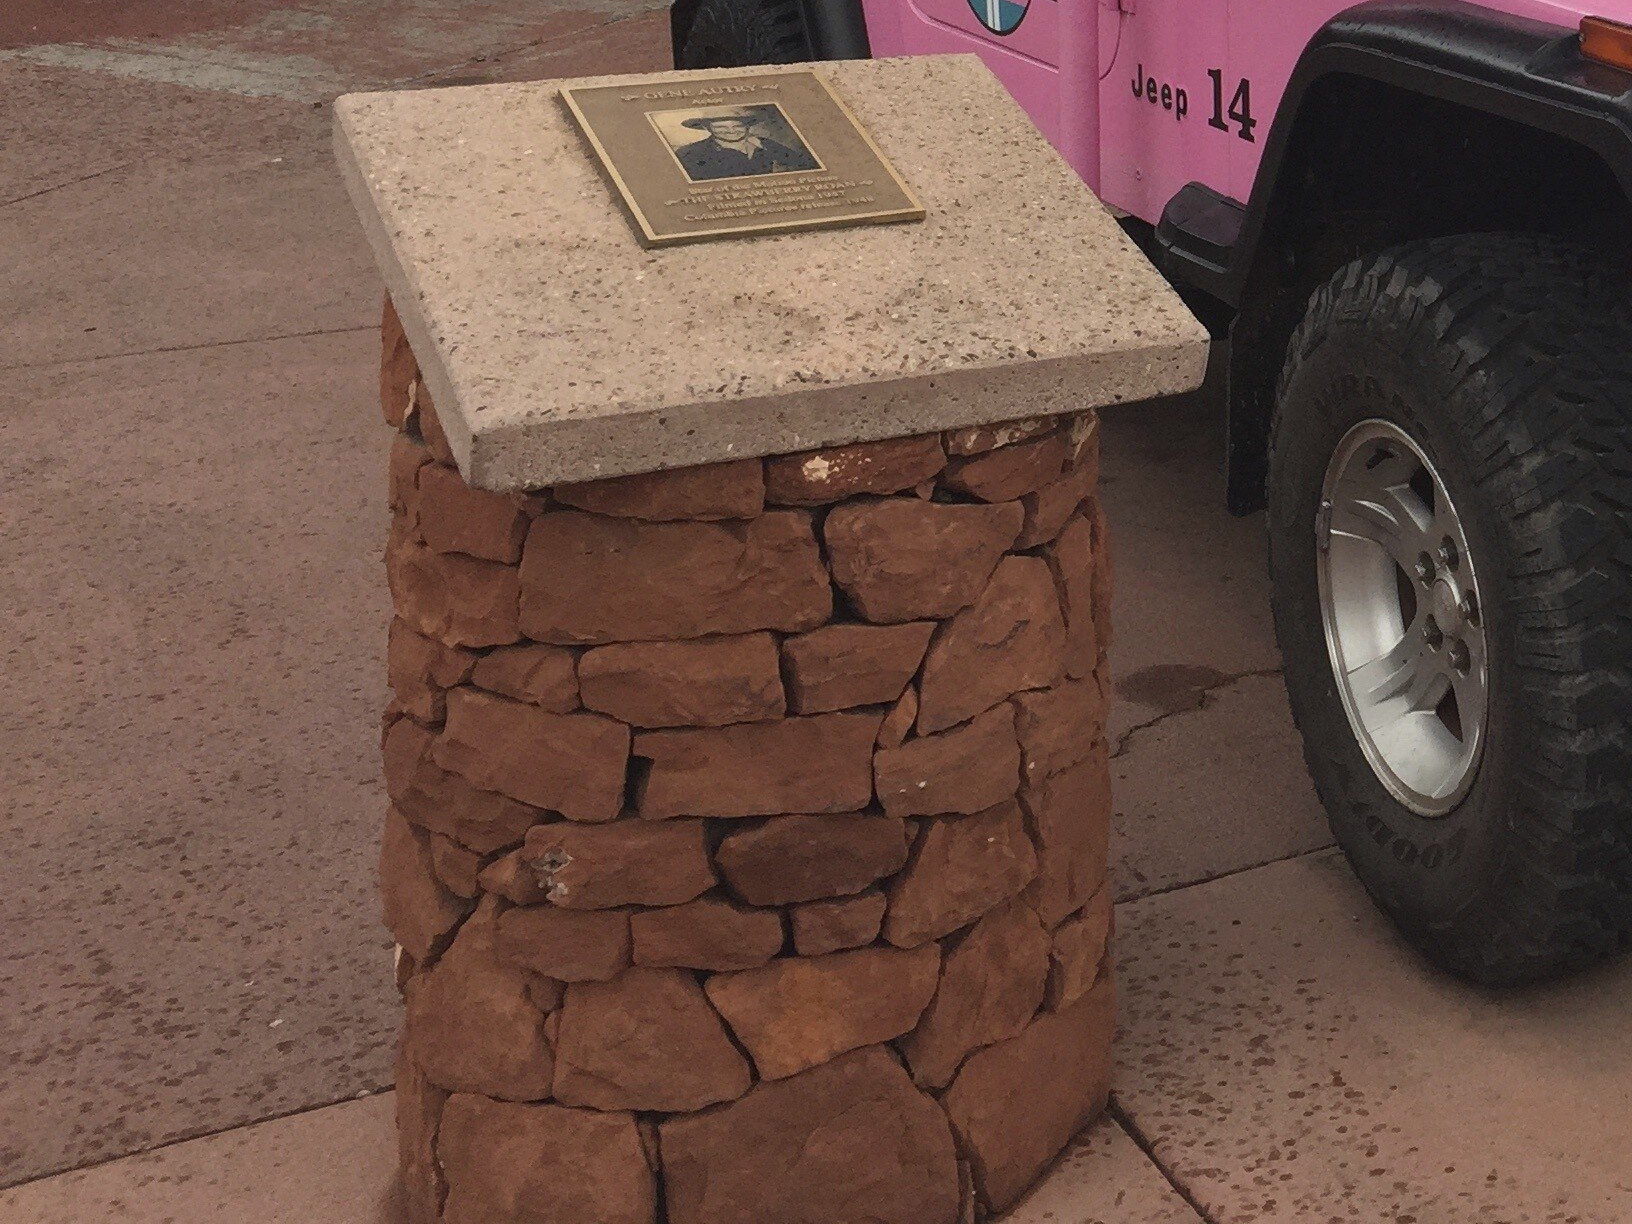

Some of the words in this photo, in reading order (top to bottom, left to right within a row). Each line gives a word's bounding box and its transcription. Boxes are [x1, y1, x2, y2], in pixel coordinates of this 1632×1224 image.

[697, 83, 757, 97] AUTRY
[1131, 63, 1188, 122] Jeep
[1207, 68, 1258, 144] 14
